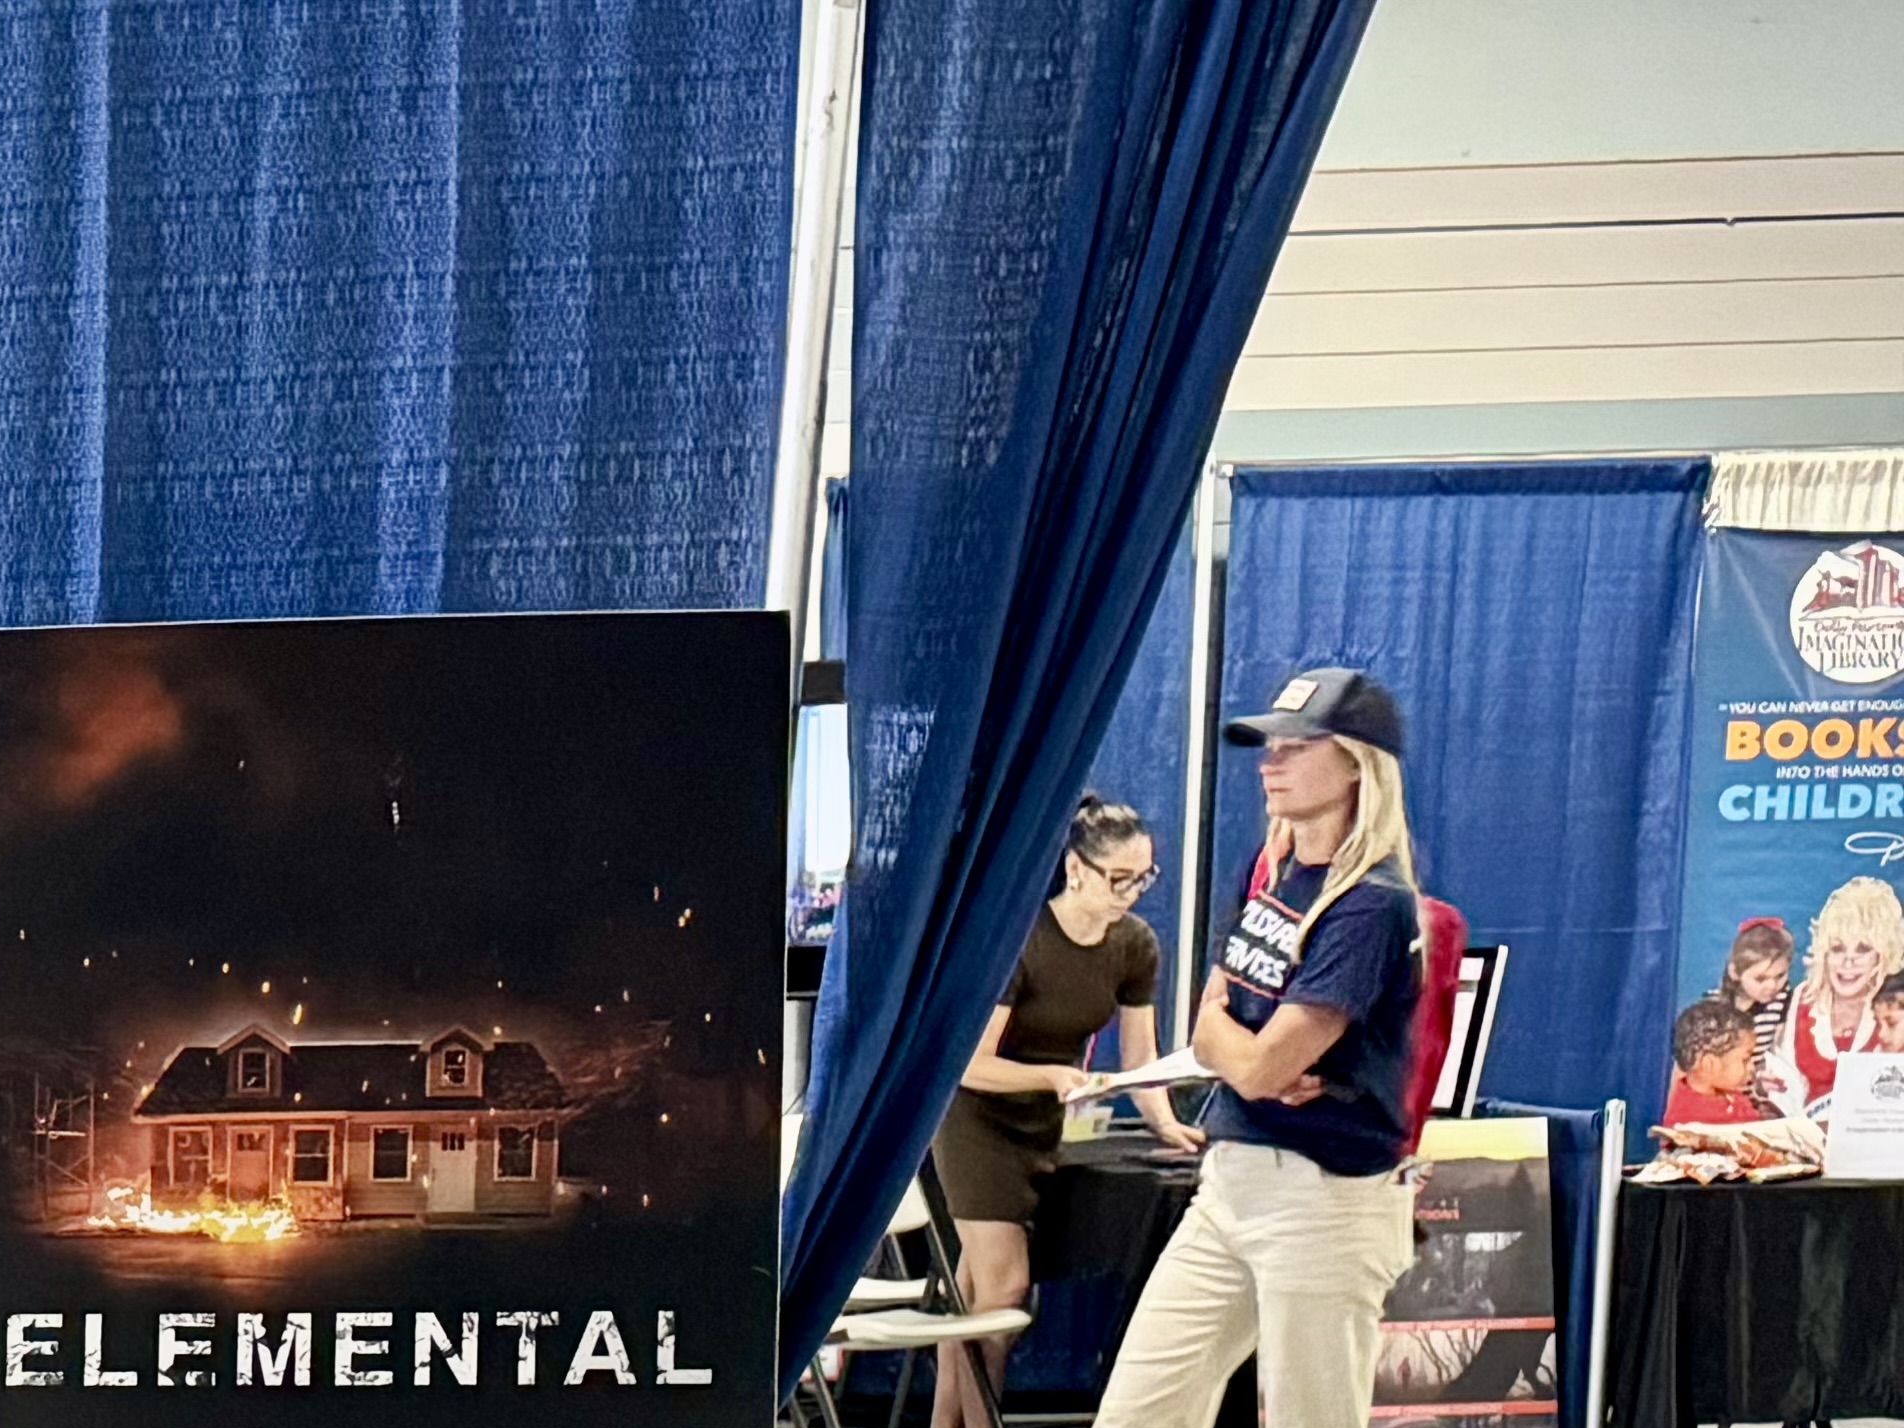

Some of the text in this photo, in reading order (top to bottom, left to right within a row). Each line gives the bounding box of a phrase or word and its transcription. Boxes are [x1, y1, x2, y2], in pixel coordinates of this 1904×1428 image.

[1758, 702, 1786, 714] CAN
[1789, 701, 1829, 714] NEVER
[1831, 701, 1855, 712] GET
[1776, 765, 1889, 778] INTO THE HANDS
[5, 1310, 713, 1387] ELEMENTAL
